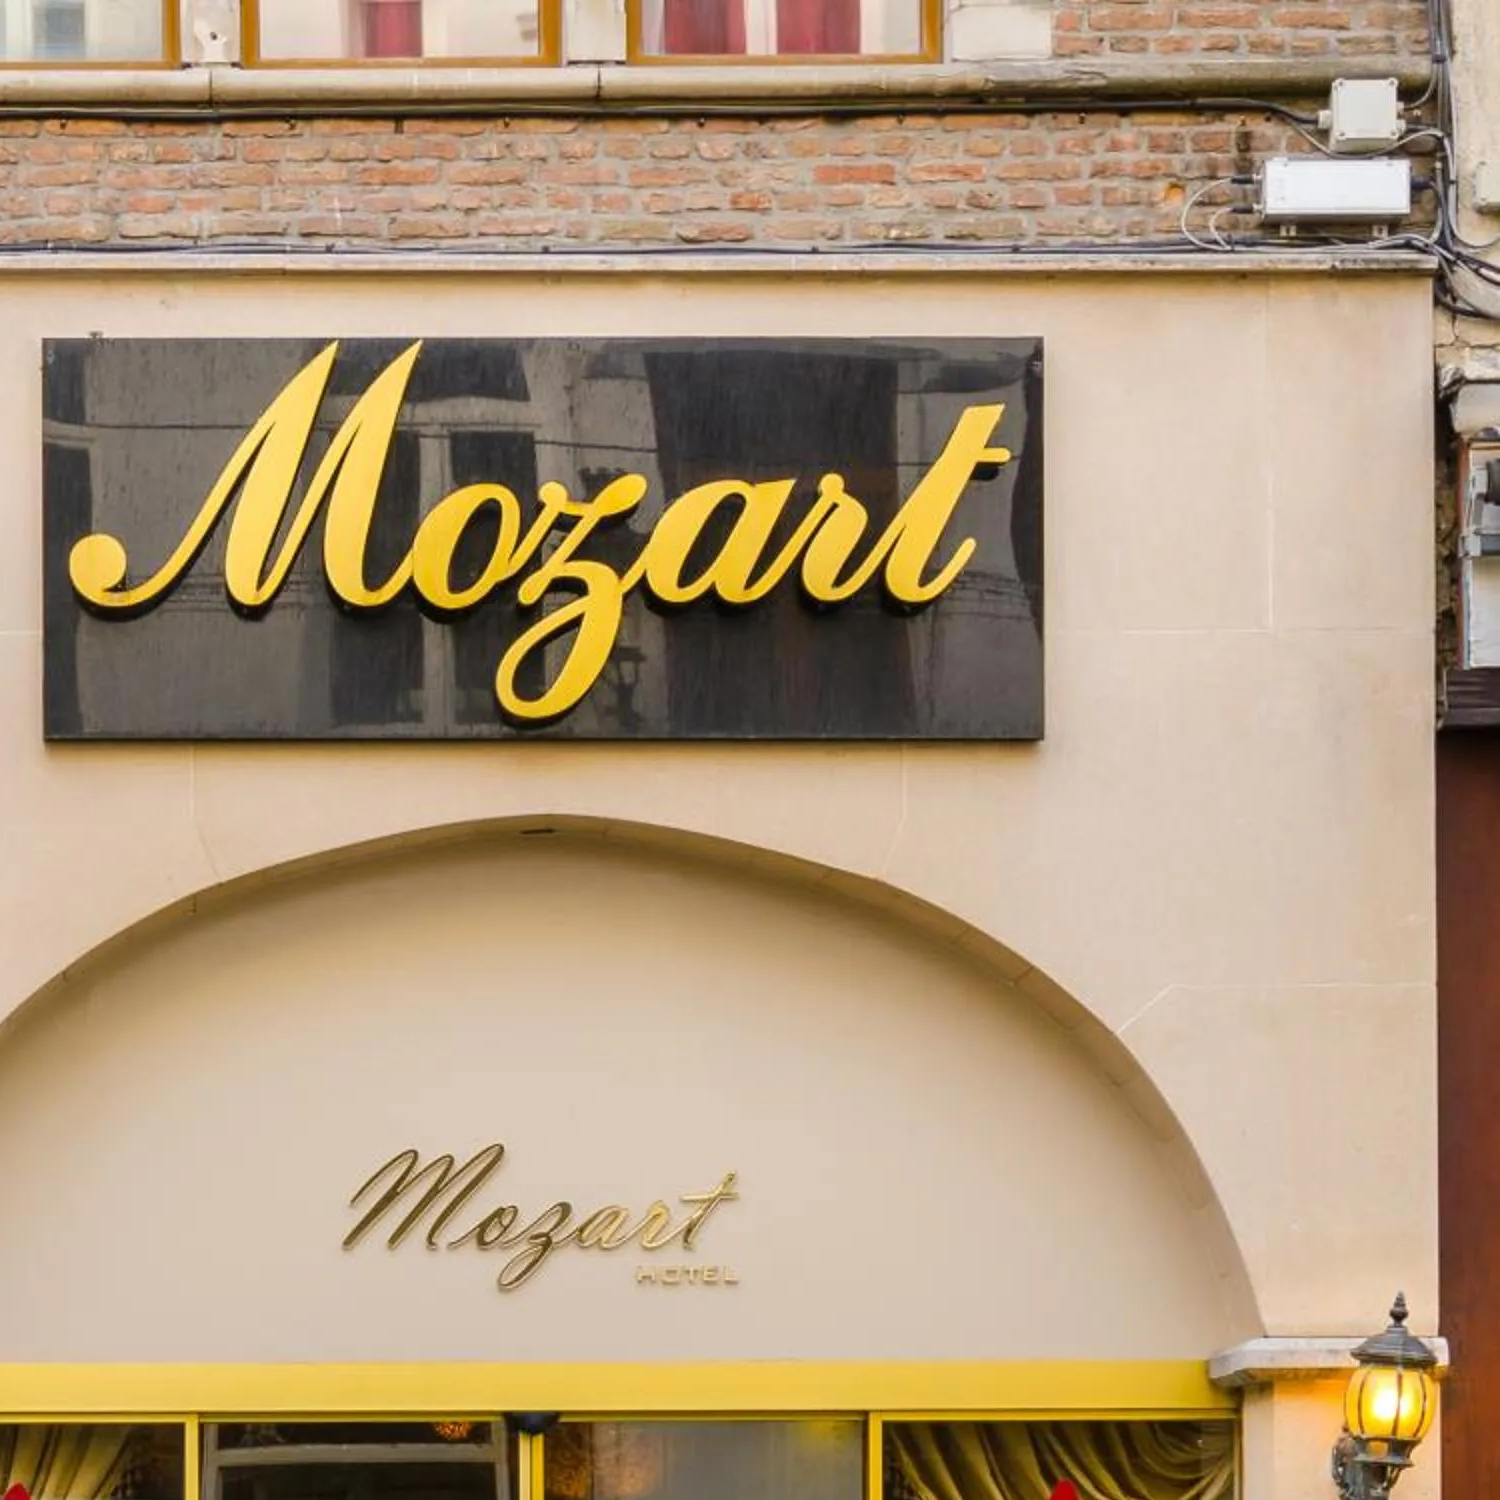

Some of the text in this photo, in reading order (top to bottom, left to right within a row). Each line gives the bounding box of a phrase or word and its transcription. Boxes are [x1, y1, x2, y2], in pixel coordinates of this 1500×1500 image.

[69, 340, 1010, 720] Mozart
[342, 1143, 740, 1291] Mozart
[636, 1264, 740, 1286] HOTEL
